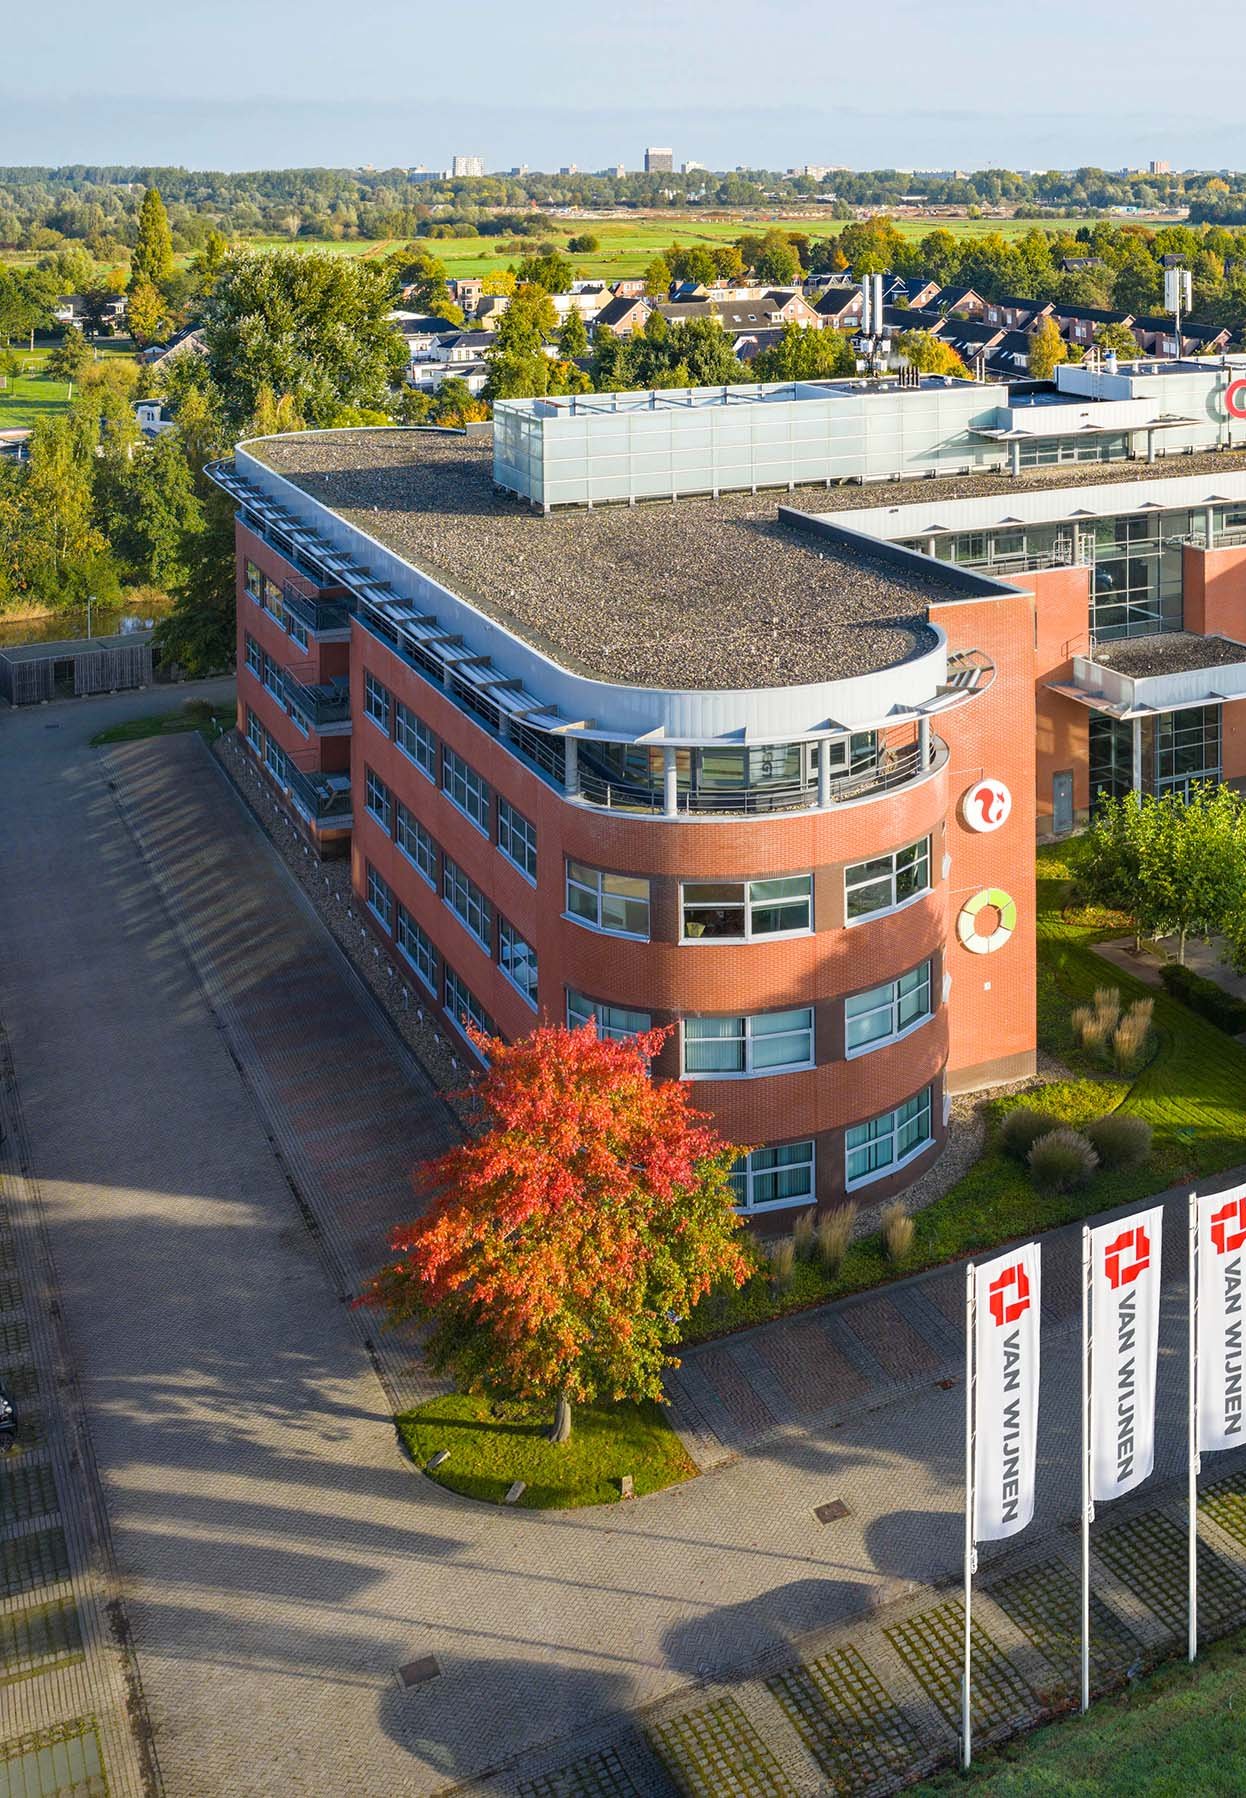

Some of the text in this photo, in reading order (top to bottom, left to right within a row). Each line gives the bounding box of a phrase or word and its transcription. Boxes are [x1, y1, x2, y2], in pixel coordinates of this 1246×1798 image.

[1001, 1328, 1021, 1524] VAN WIJNEN
[1116, 1289, 1136, 1483] VAN WIJNEN
[1224, 1256, 1242, 1436] VAN WIJNEN
